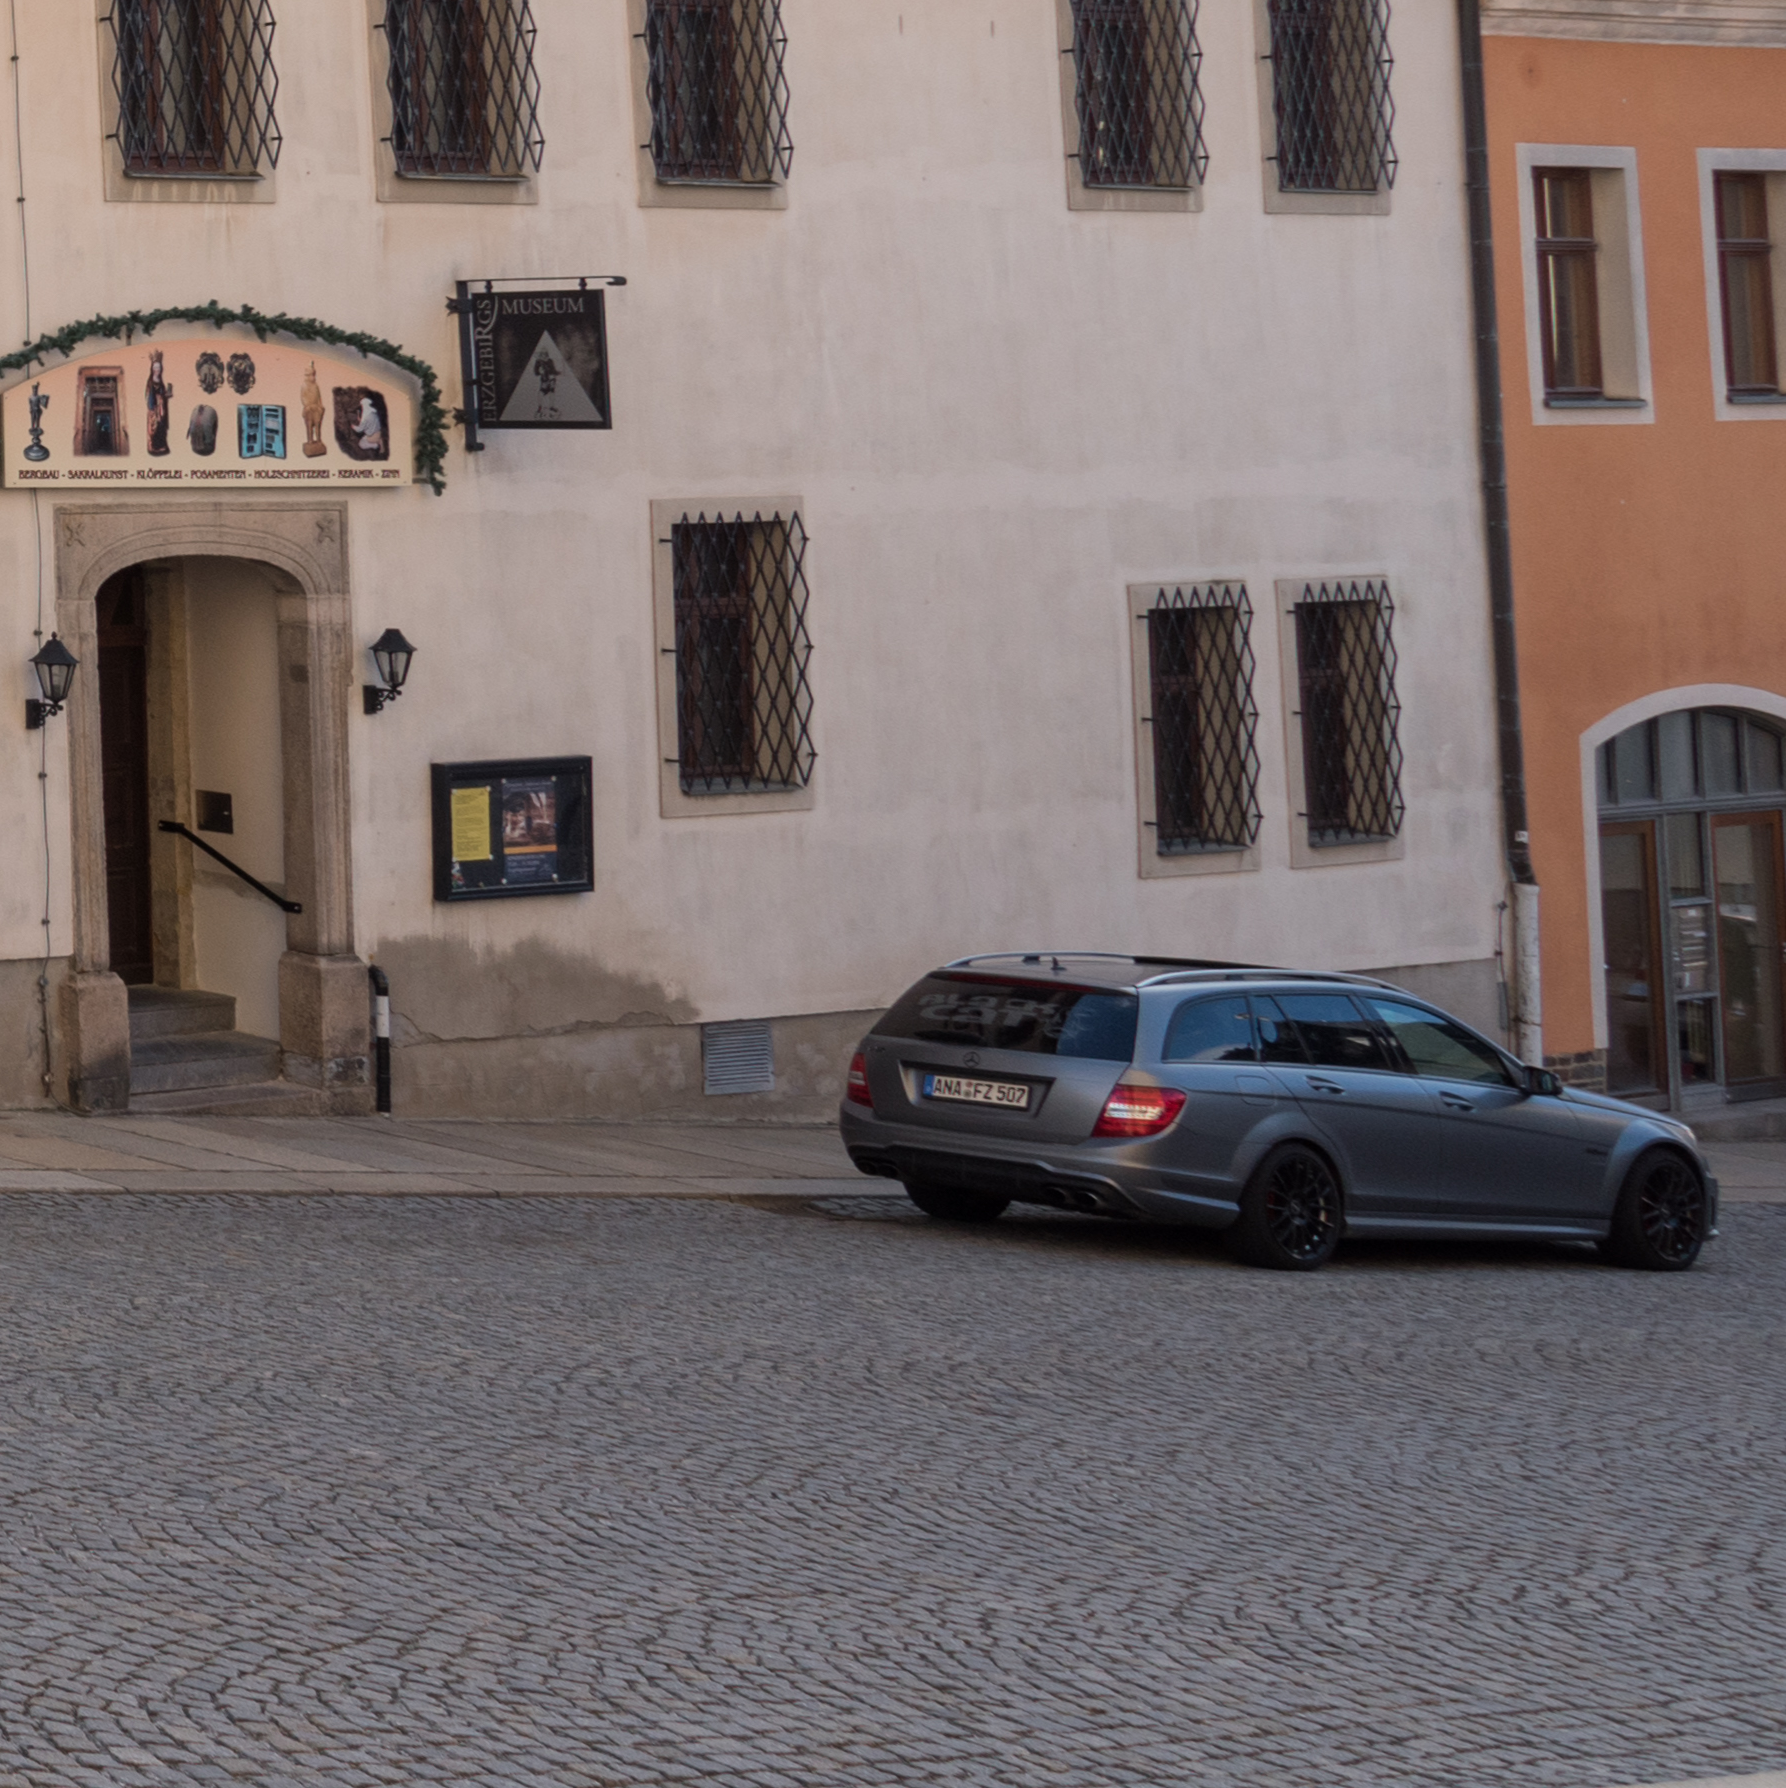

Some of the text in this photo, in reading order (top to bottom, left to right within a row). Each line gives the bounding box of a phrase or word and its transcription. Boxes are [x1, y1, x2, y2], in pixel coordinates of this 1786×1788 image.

[501, 297, 584, 315] MUSEUM
[475, 295, 499, 422] ERZGEBIRGS
[18, 469, 60, 480] BERGBAU
[67, 469, 129, 480] SAKRALKUNST
[136, 467, 183, 481] KLÖPPELEI
[190, 469, 247, 480] POSAMENTEN
[253, 469, 330, 480] HOLZSCHNITZEREI
[337, 469, 374, 479] KERAMIK
[380, 469, 401, 479] ZINN
[933, 1077, 1026, 1103] ANA FZ 507
